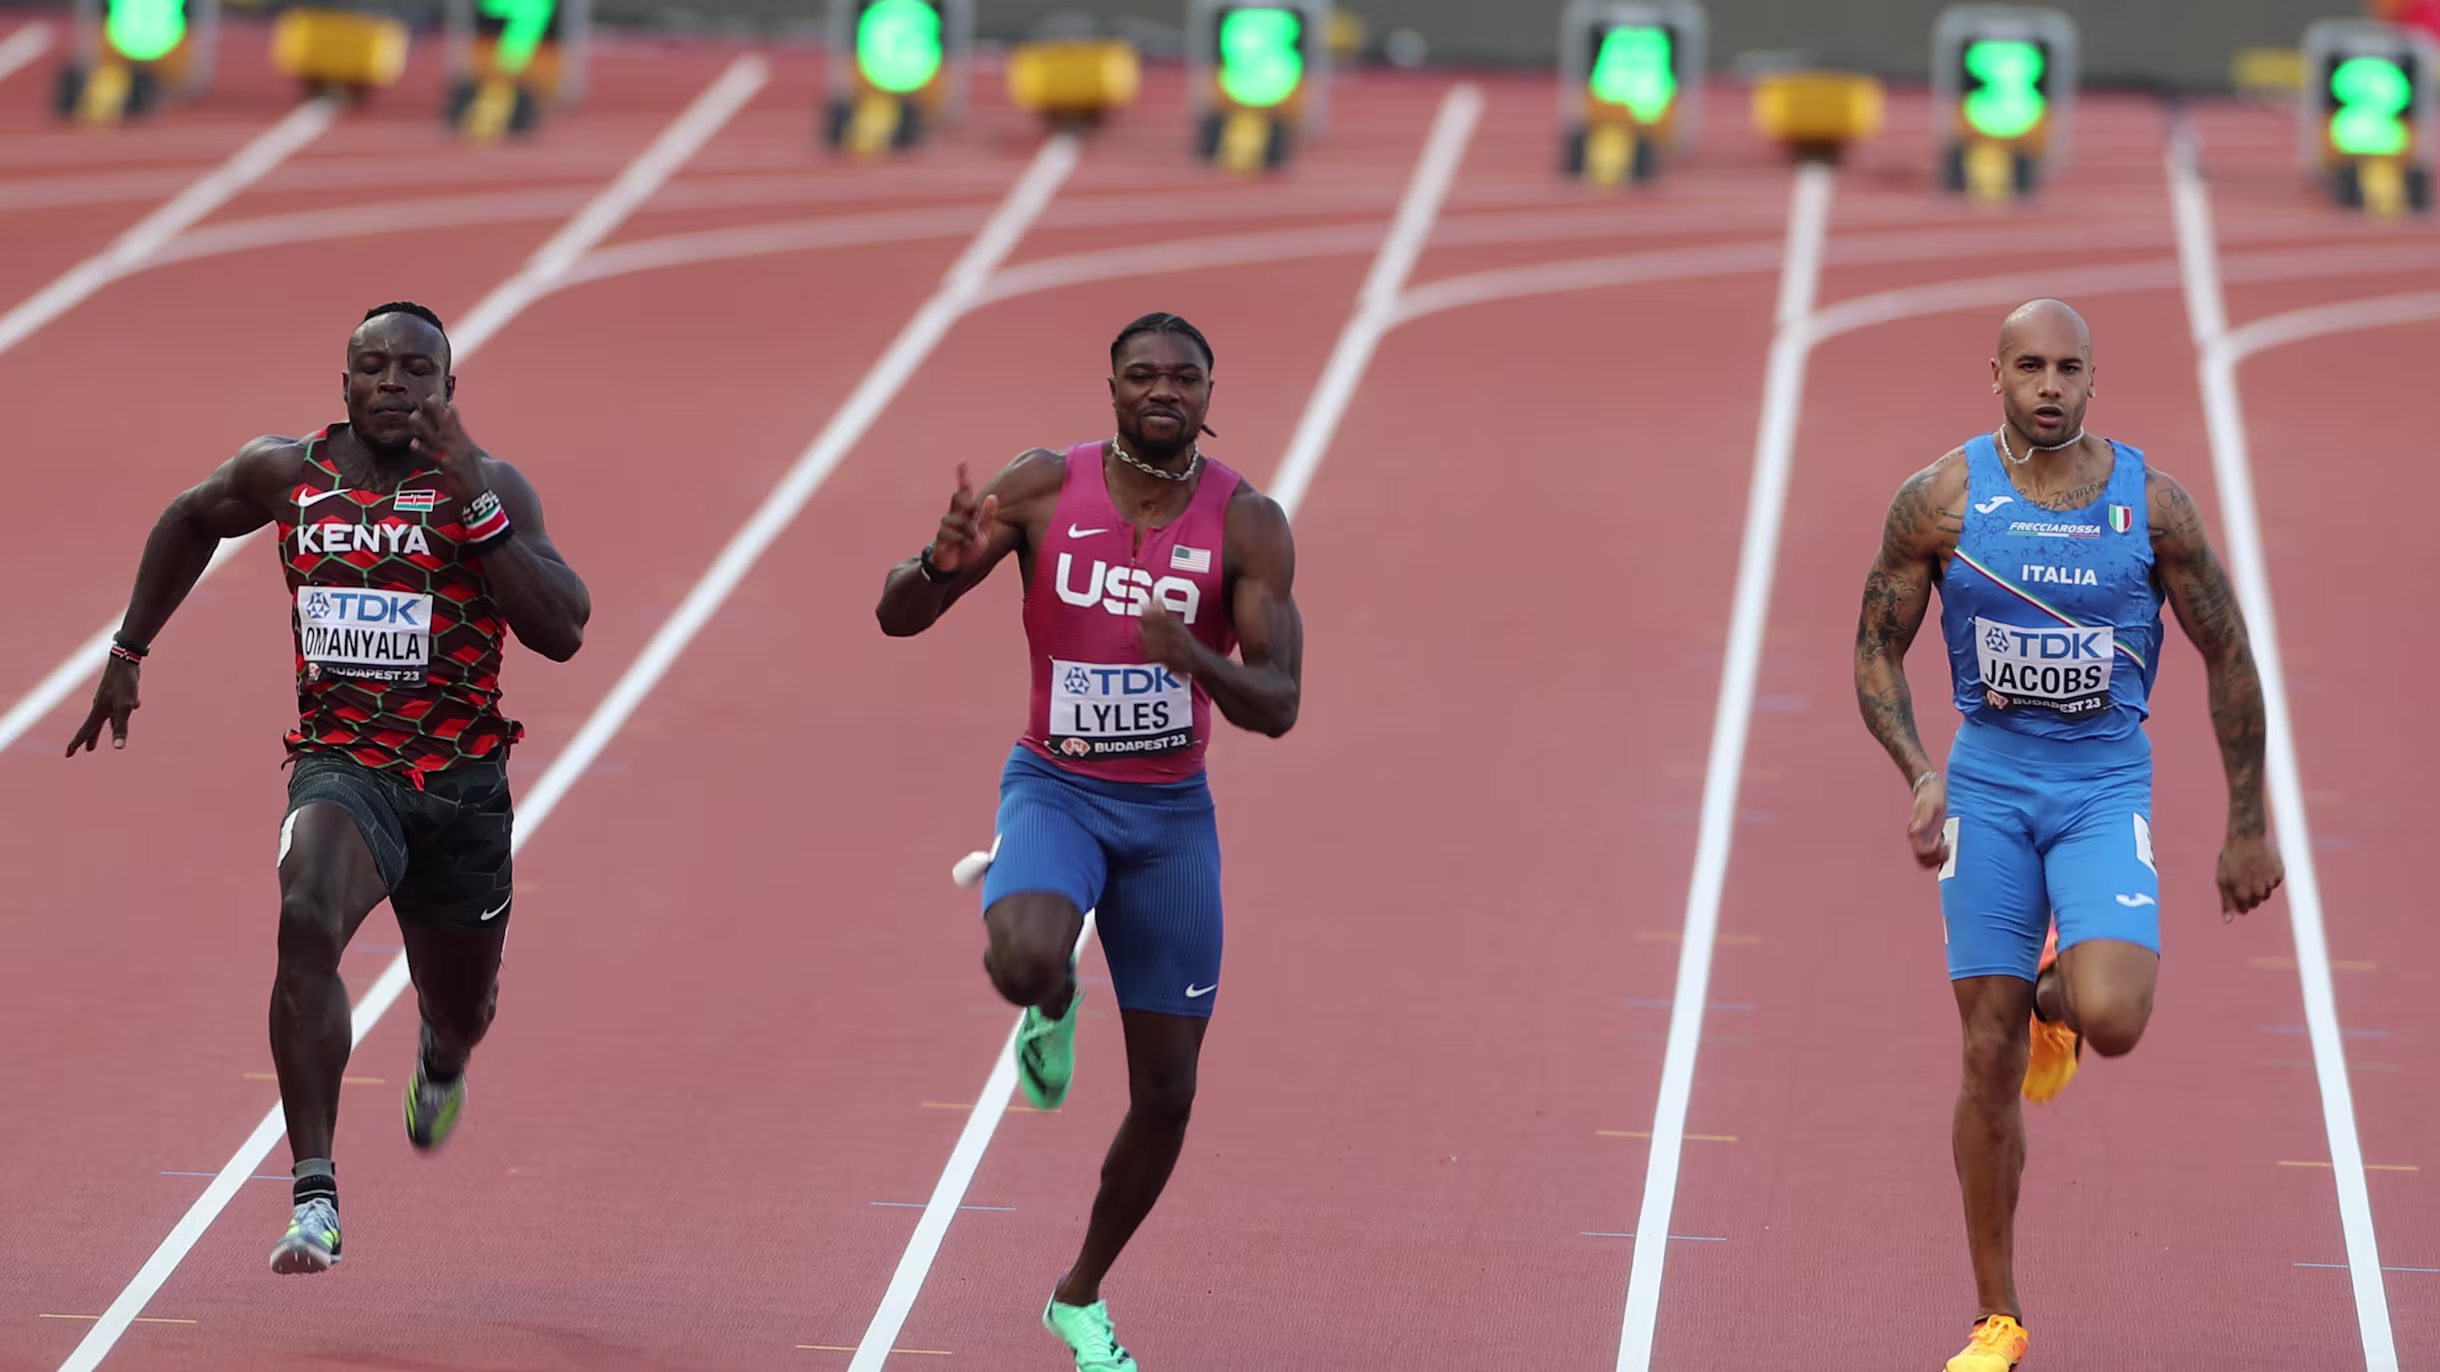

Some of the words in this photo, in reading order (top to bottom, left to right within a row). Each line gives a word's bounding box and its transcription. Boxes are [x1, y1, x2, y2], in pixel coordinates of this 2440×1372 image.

[482, 0, 555, 68] 7
[1592, 28, 1676, 118] 4
[1966, 42, 2044, 134] 3
[2332, 58, 2410, 152] 2
[297, 523, 431, 555] KENYA
[2009, 521, 2101, 534] FRECCIAROSSA
[1055, 552, 1201, 625] USA
[2022, 564, 2098, 586] ITALIA
[330, 593, 420, 626] TDK
[305, 626, 421, 661] OMANYALA
[2010, 632, 2101, 659] TDK
[403, 671, 420, 681] 23
[1090, 667, 1181, 695] TDK
[1985, 659, 2102, 694] JACOBS
[1075, 701, 1169, 733] LYLES
[2085, 698, 2101, 710] 23
[1095, 739, 1170, 753] BUDAPEST
[1170, 733, 1187, 746] 23
